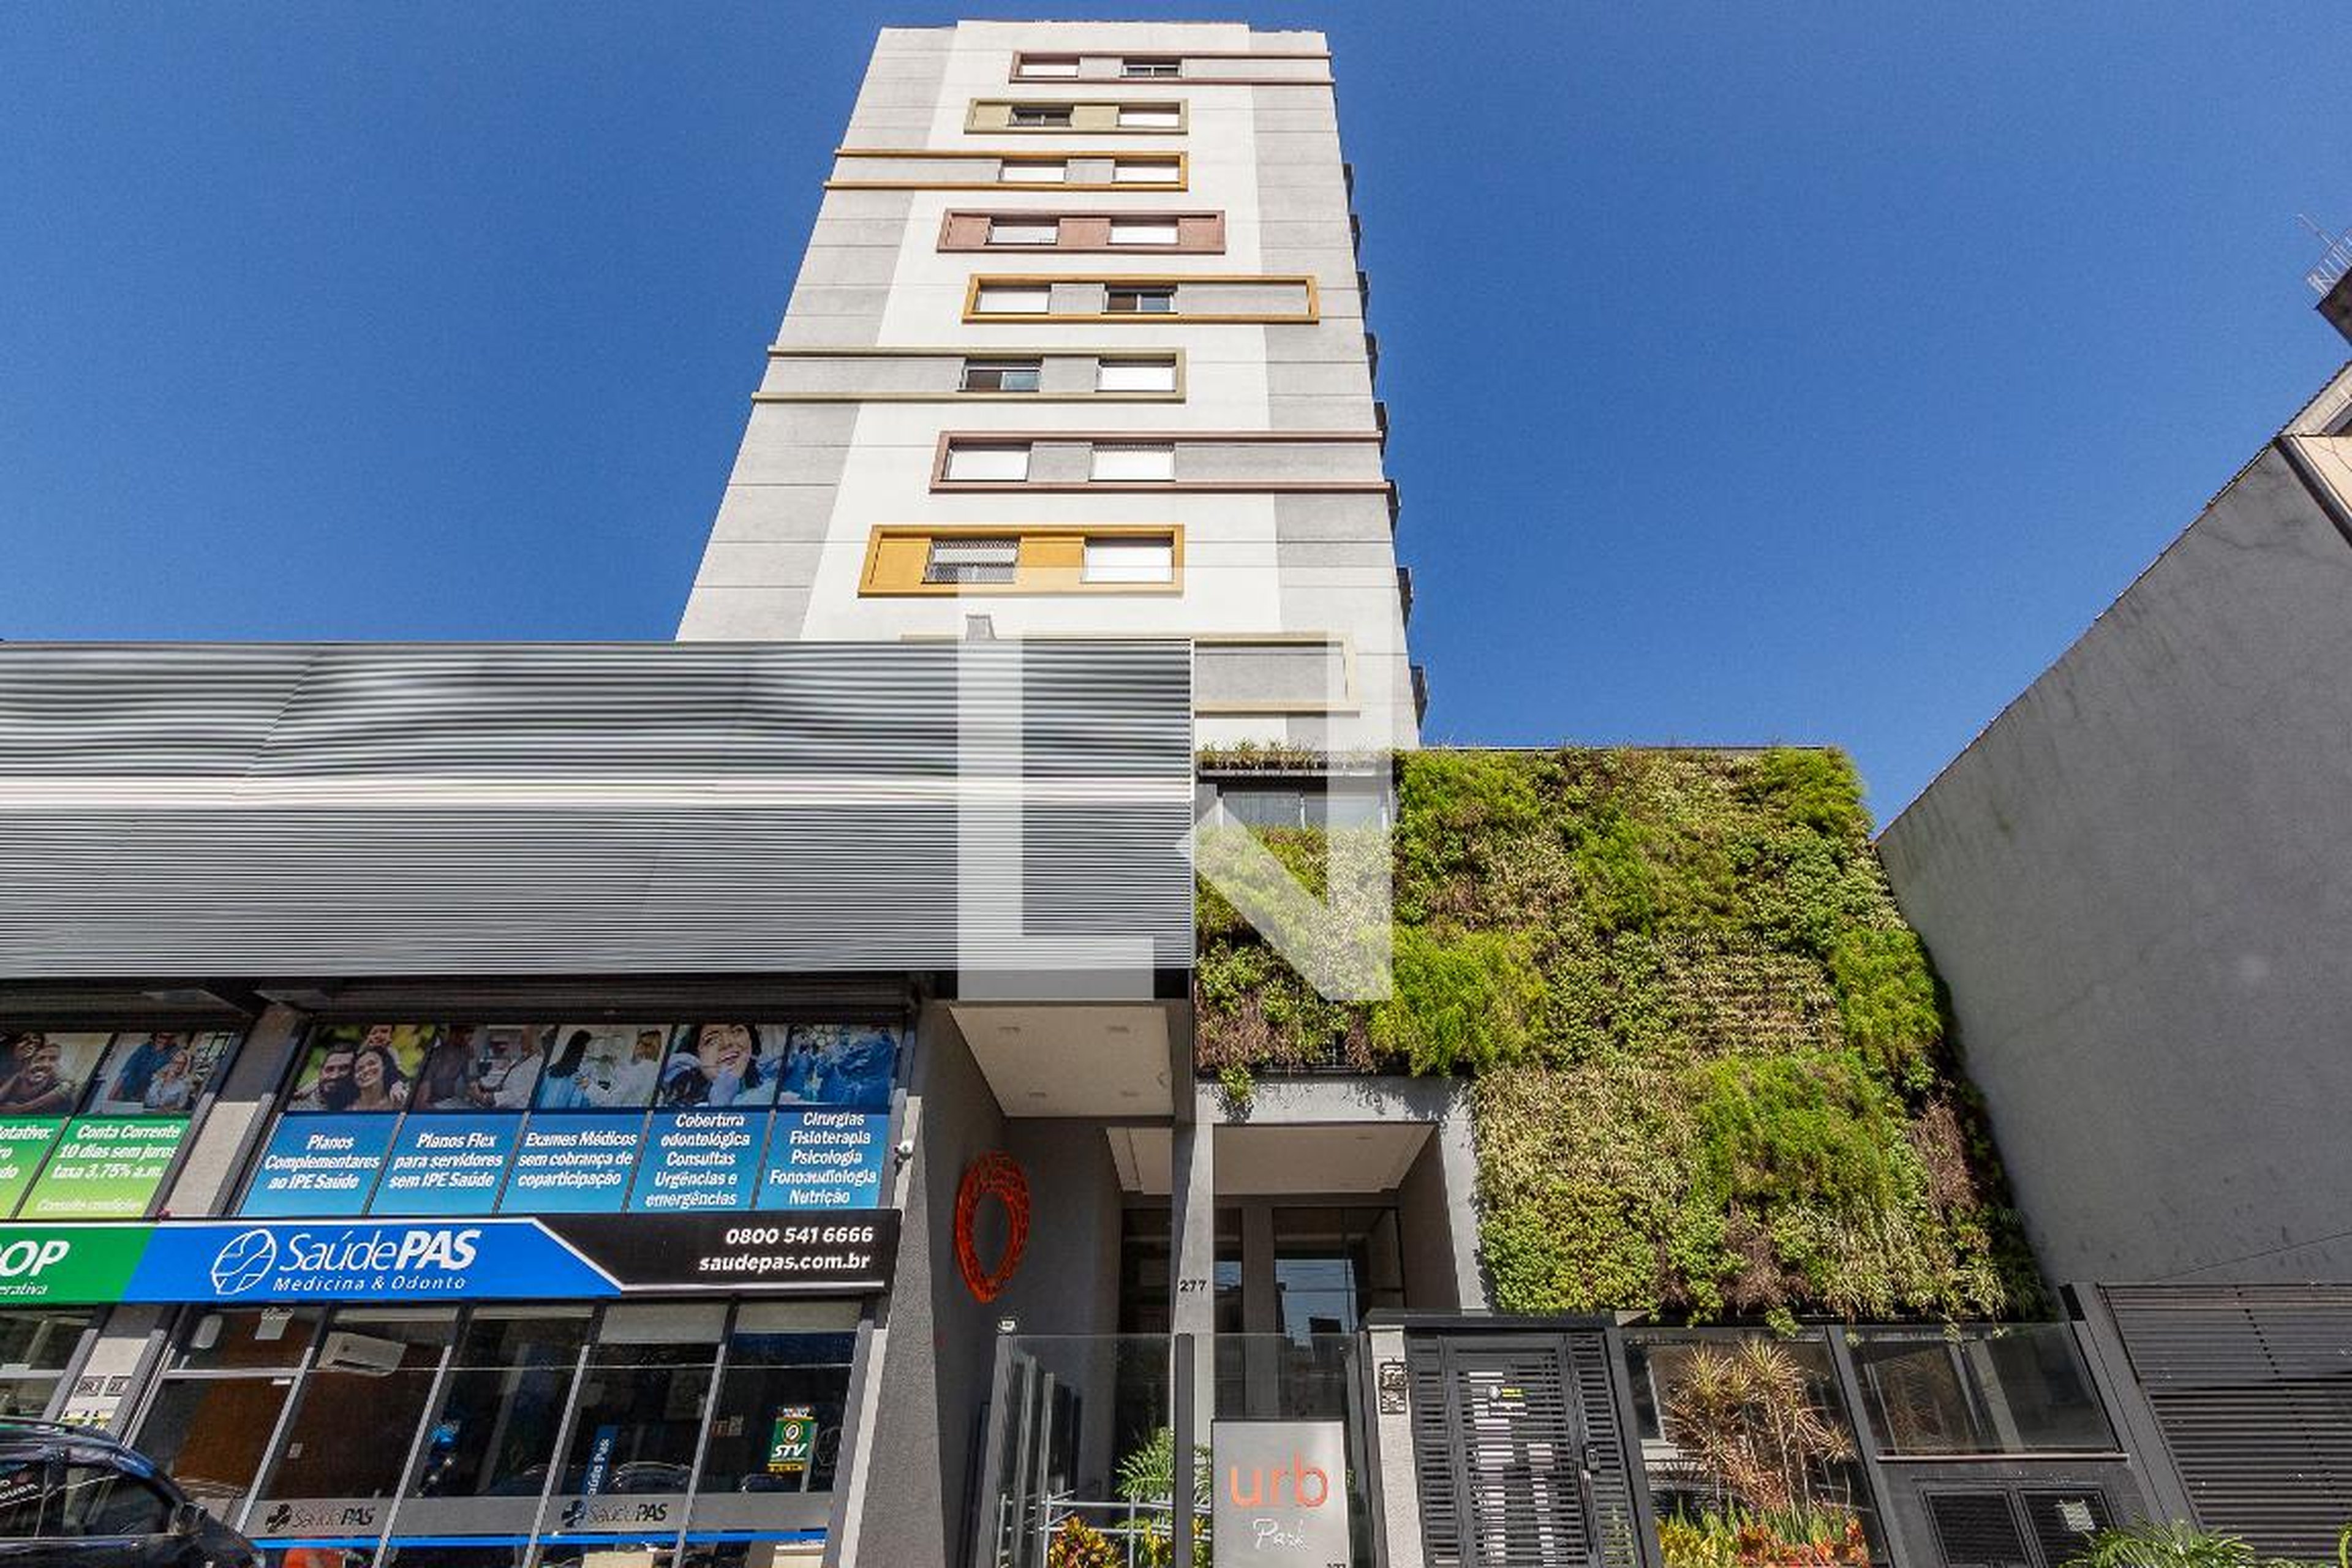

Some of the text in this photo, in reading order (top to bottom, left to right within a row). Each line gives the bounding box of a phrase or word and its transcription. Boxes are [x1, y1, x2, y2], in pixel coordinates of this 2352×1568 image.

[676, 1112, 745, 1127] Cobertura
[804, 1112, 864, 1128] Cirurgias
[77, 1125, 182, 1139] Conta Corrente
[416, 1133, 497, 1148] Planos Flex
[525, 1131, 637, 1147] Exames Médicos
[661, 1131, 750, 1150] odontológica
[790, 1130, 871, 1147] Fisioterapia
[307, 1134, 355, 1150] Planos
[59, 1144, 178, 1161] 10 dias sem juros
[518, 1152, 633, 1169] sem cobrança de
[667, 1152, 736, 1166] Consultas
[791, 1149, 862, 1166] Psicologia
[265, 1155, 380, 1172] Complementares
[393, 1152, 503, 1171] para servidores
[52, 1164, 85, 1178] taxa
[389, 1170, 495, 1188] sem IPE Saúde
[518, 1170, 621, 1189] coparticipação
[655, 1170, 738, 1189] Urgências e
[770, 1169, 877, 1187] Fonoaudiologia
[268, 1171, 360, 1189] ao IPE Saúde
[646, 1190, 736, 1209] emergências
[789, 1189, 850, 1206] Nutrição
[725, 1227, 873, 1244] 0800 541 6666
[0, 1240, 70, 1276] OP
[279, 1230, 481, 1271] SaúdePAS
[699, 1253, 870, 1273] saudepas.com.br
[273, 1275, 466, 1291] Medicina & Odonto
[1180, 1280, 1207, 1292] 277
[772, 1443, 807, 1458] STV
[1231, 1448, 1328, 1507] urb
